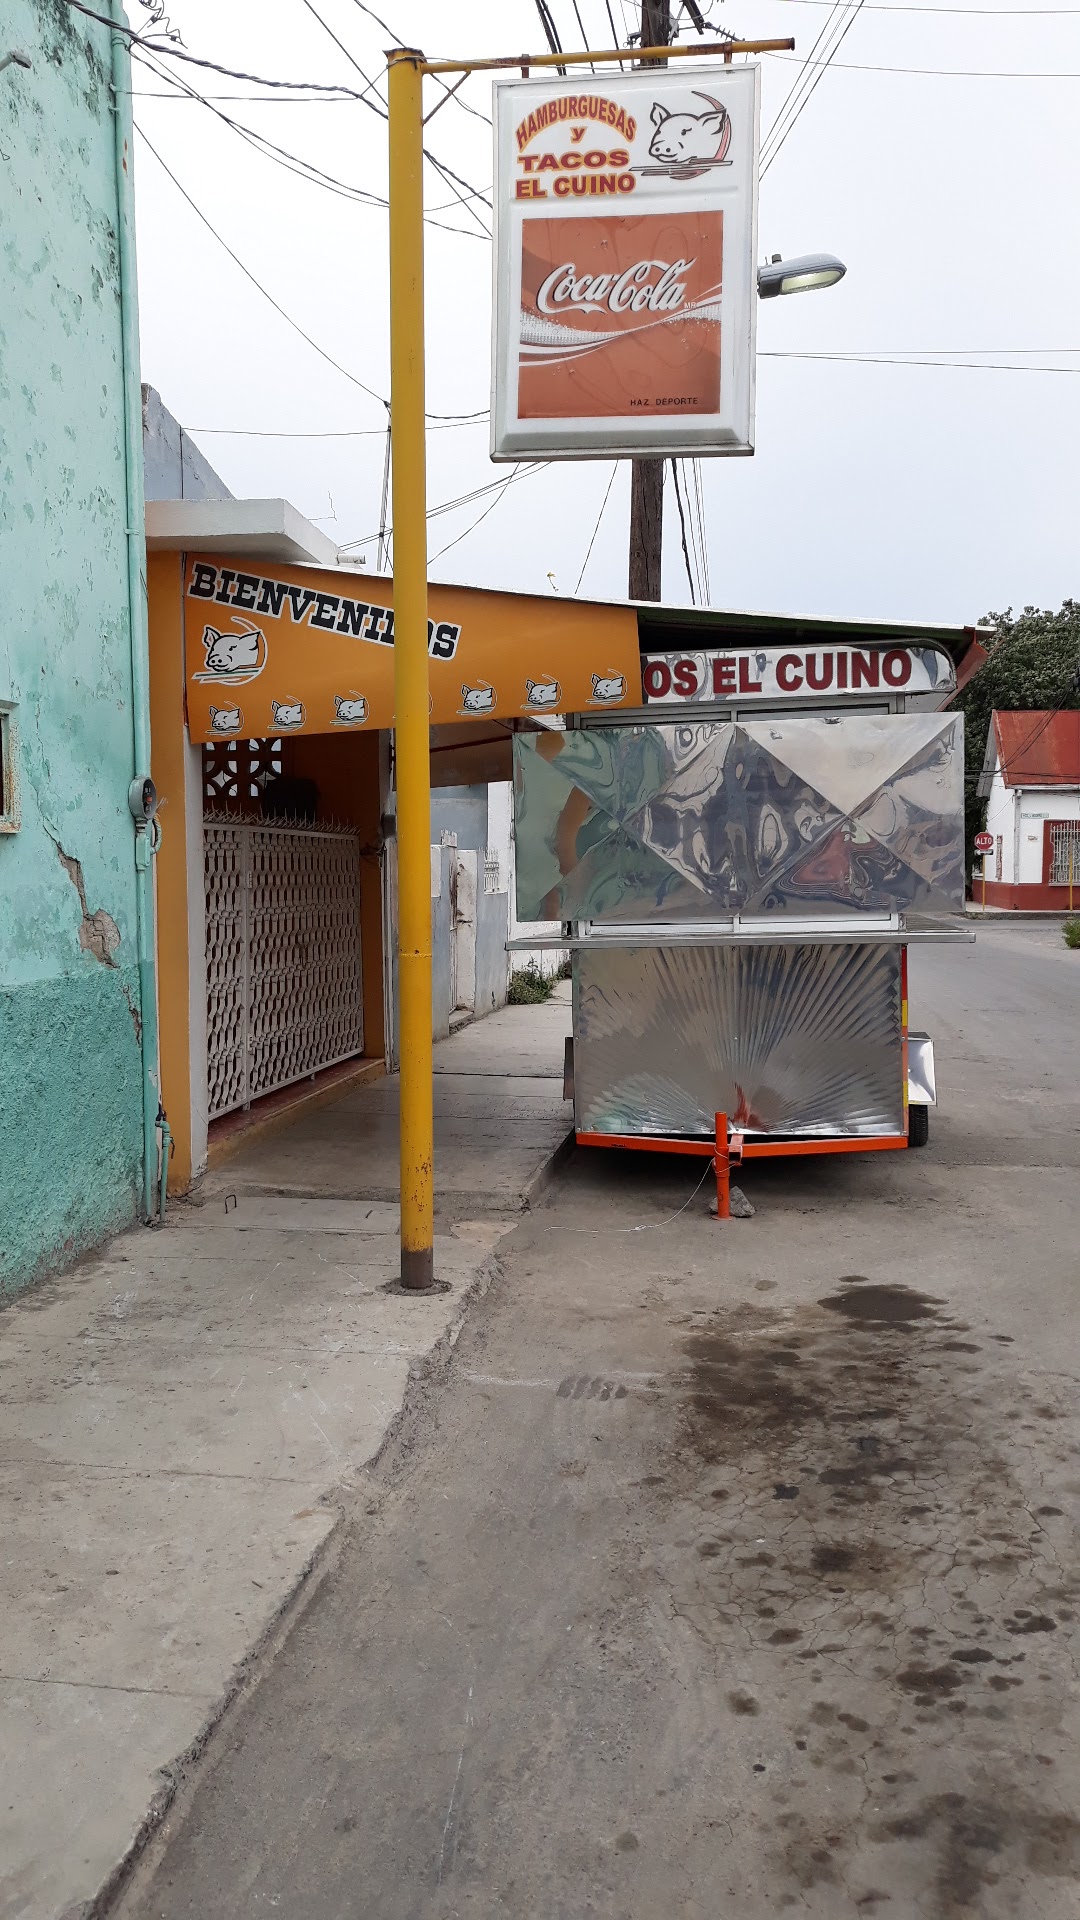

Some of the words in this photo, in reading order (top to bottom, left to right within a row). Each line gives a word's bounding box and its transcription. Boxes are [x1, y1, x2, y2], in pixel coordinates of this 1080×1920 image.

[516, 95, 637, 152] HAMBURGUESAS
[518, 149, 630, 174] TACOS
[516, 178, 548, 199] EL
[553, 172, 637, 198] CUINO
[536, 257, 698, 315] Coca-Cola
[655, 397, 699, 406] DEPORTE
[187, 560, 462, 661] BIENVENIS
[712, 657, 762, 694] EL
[775, 649, 912, 692] CUINO
[976, 837, 992, 845] ALTO
